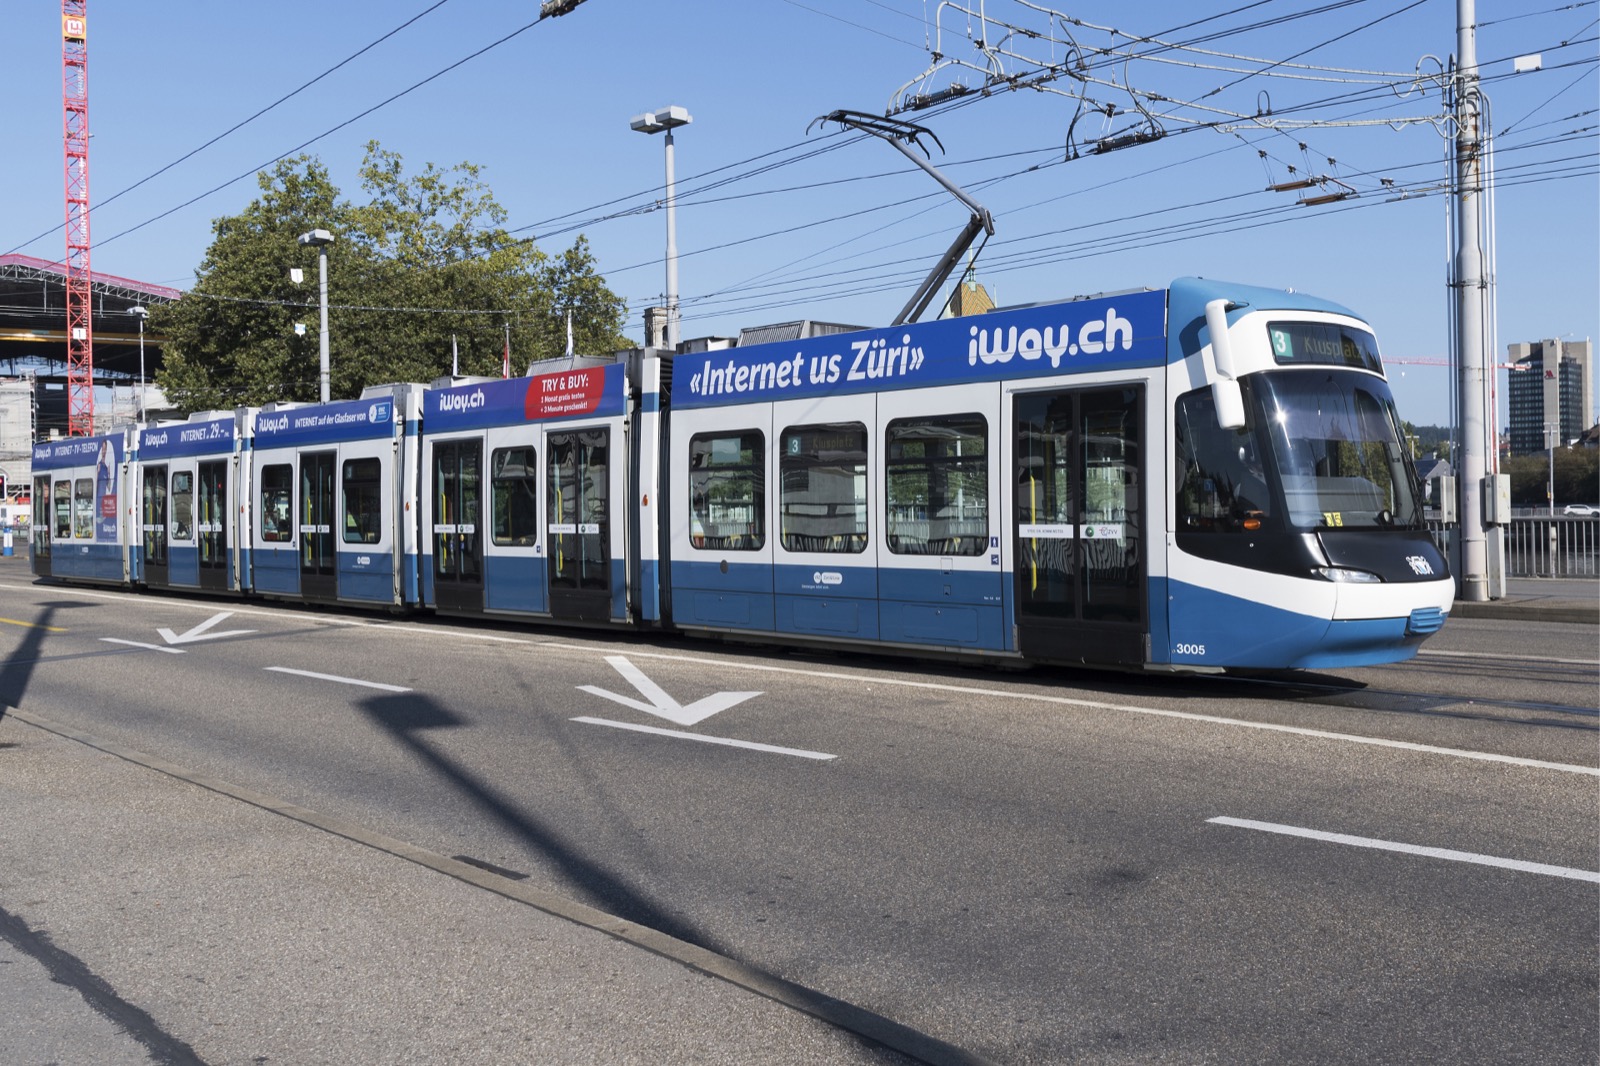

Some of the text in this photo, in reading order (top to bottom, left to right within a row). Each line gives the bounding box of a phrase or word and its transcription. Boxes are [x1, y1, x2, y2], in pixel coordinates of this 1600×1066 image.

[968, 307, 1133, 368] iway.ch
[1275, 331, 1364, 359] 3 Klusplatz
[690, 334, 925, 396] «Internet us Züri»
[542, 374, 589, 392] TRY & BUY:
[440, 388, 485, 413] iway.ch
[545, 395, 558, 403] Monat
[558, 393, 571, 403] gratis
[259, 414, 289, 434] iway.ch
[295, 416, 318, 428] INTERNET
[318, 415, 327, 426] auf
[327, 414, 335, 424] der
[335, 412, 357, 424] Glasfaser
[357, 412, 366, 421] von
[145, 431, 168, 448] iway.ch
[181, 427, 206, 442] INTERNET
[55, 445, 72, 456] INTERNET
[81, 442, 98, 453] TELEFON
[792, 439, 798, 453] 3
[1176, 643, 1206, 656] 3005
